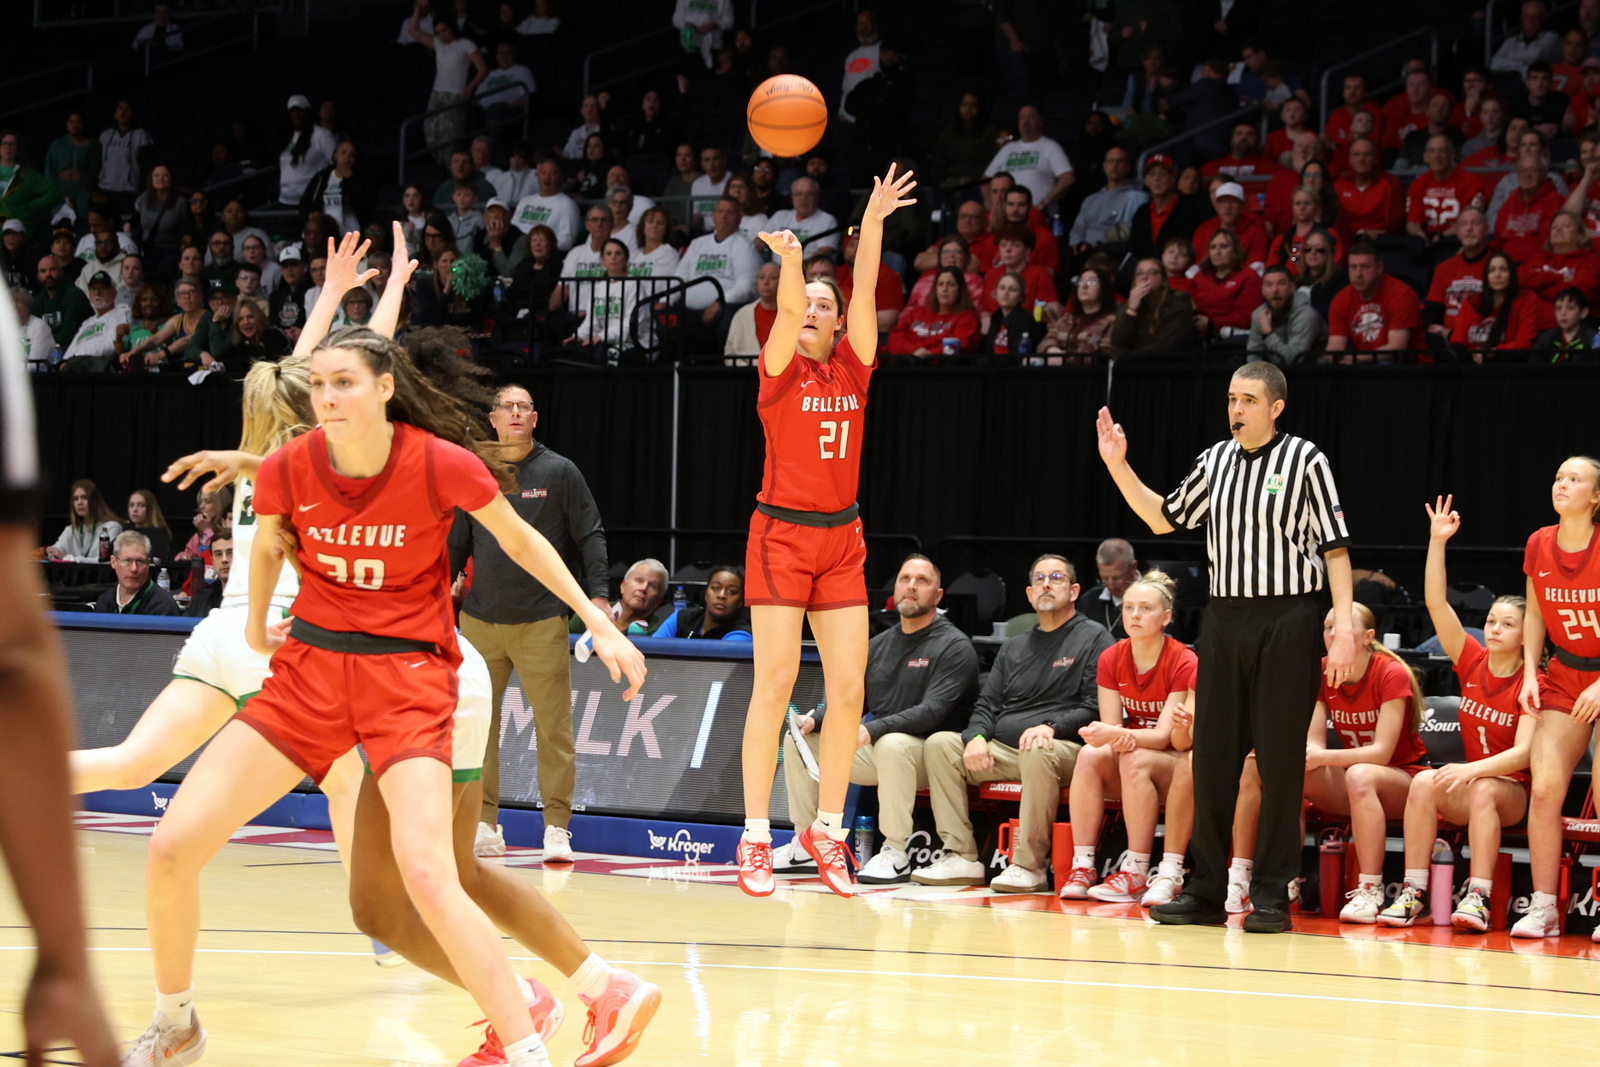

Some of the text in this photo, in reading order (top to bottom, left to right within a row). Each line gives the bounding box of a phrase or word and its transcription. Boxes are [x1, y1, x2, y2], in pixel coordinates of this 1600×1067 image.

[818, 420, 850, 460] 21
[316, 552, 385, 591] 30
[1556, 608, 1600, 641] 24
[1120, 695, 1166, 712] ELLEVU
[1331, 708, 1380, 725] ELLEVU
[499, 686, 678, 758] MLK
[1477, 725, 1490, 754] 1
[1566, 822, 1600, 833] DAYTO
[667, 829, 715, 863] Kroger
